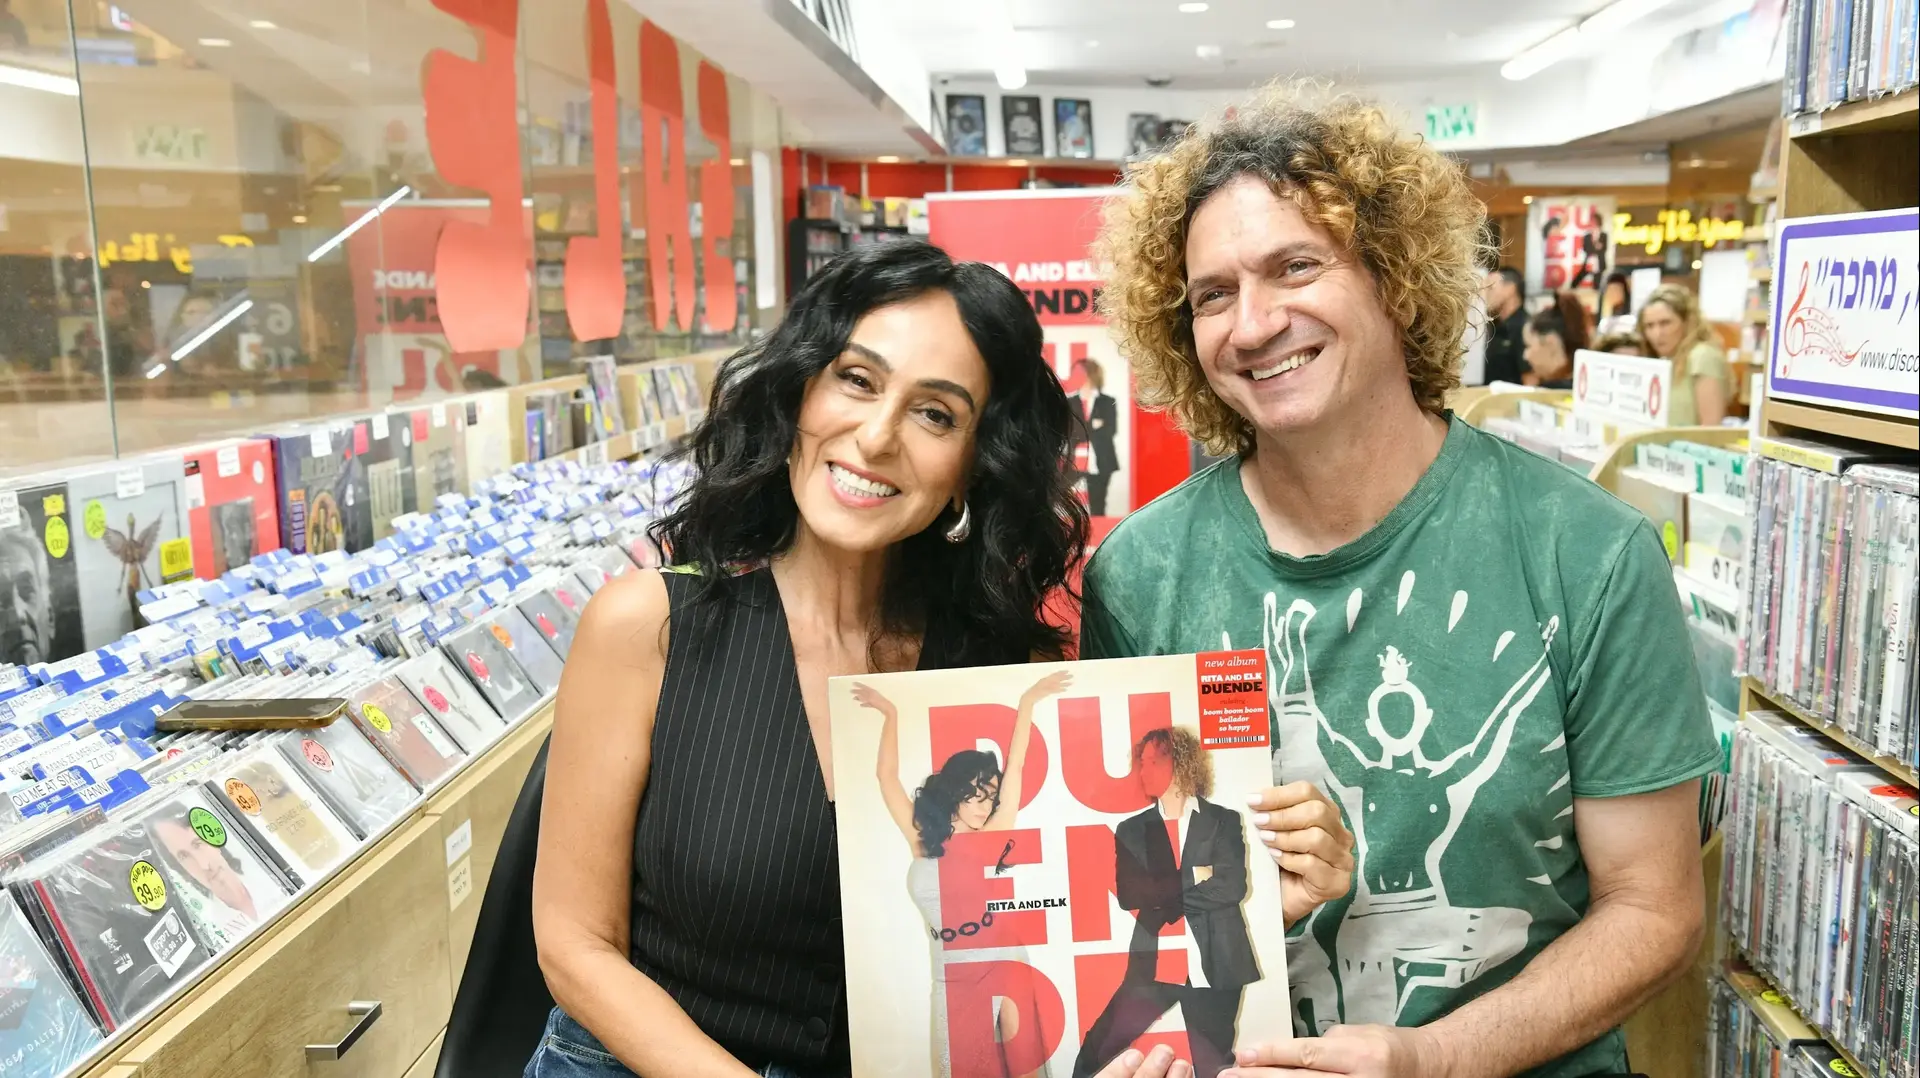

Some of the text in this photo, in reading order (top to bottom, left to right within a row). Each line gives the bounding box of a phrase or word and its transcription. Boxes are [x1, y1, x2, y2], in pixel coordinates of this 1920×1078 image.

[1014, 261, 1064, 282] AND
[1205, 656, 1257, 668] new album
[1200, 672, 1262, 683] RITA AND ELK
[1201, 681, 1263, 695] DUENDE
[1203, 706, 1264, 716] boom boom boom
[1219, 715, 1249, 723] bailador
[1228, 724, 1250, 732] happy
[928, 692, 1173, 814] DU
[30, 783, 47, 801] ME
[47, 777, 59, 793] AT
[57, 771, 75, 789] SIX
[80, 781, 111, 802] YANNI
[137, 883, 164, 905] 39.90
[987, 897, 1067, 912] RITA AND ELK
